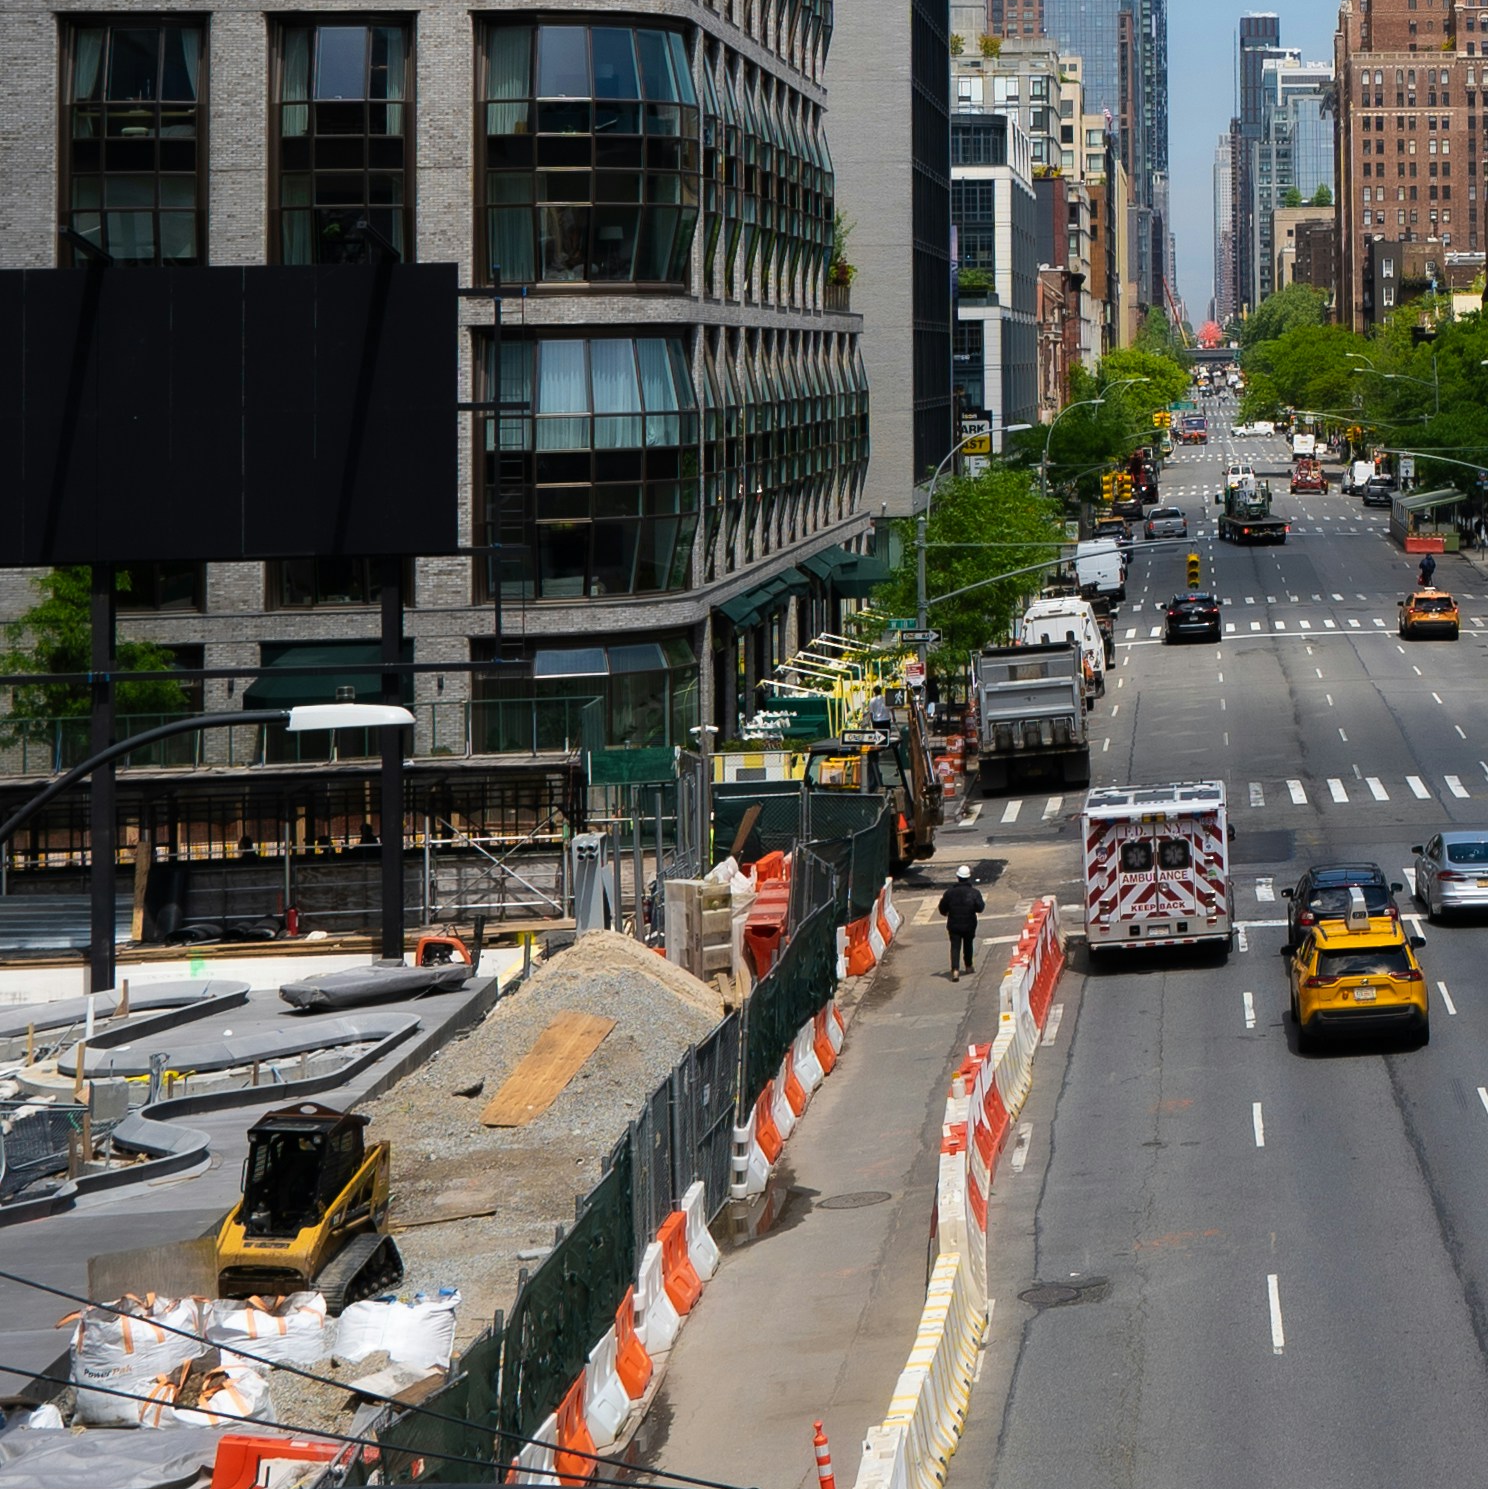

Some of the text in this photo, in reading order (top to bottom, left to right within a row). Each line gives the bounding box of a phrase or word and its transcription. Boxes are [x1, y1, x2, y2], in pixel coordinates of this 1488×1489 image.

[1163, 823, 1186, 834] N.Y.
[1131, 901, 1186, 912] KEEP BACK
